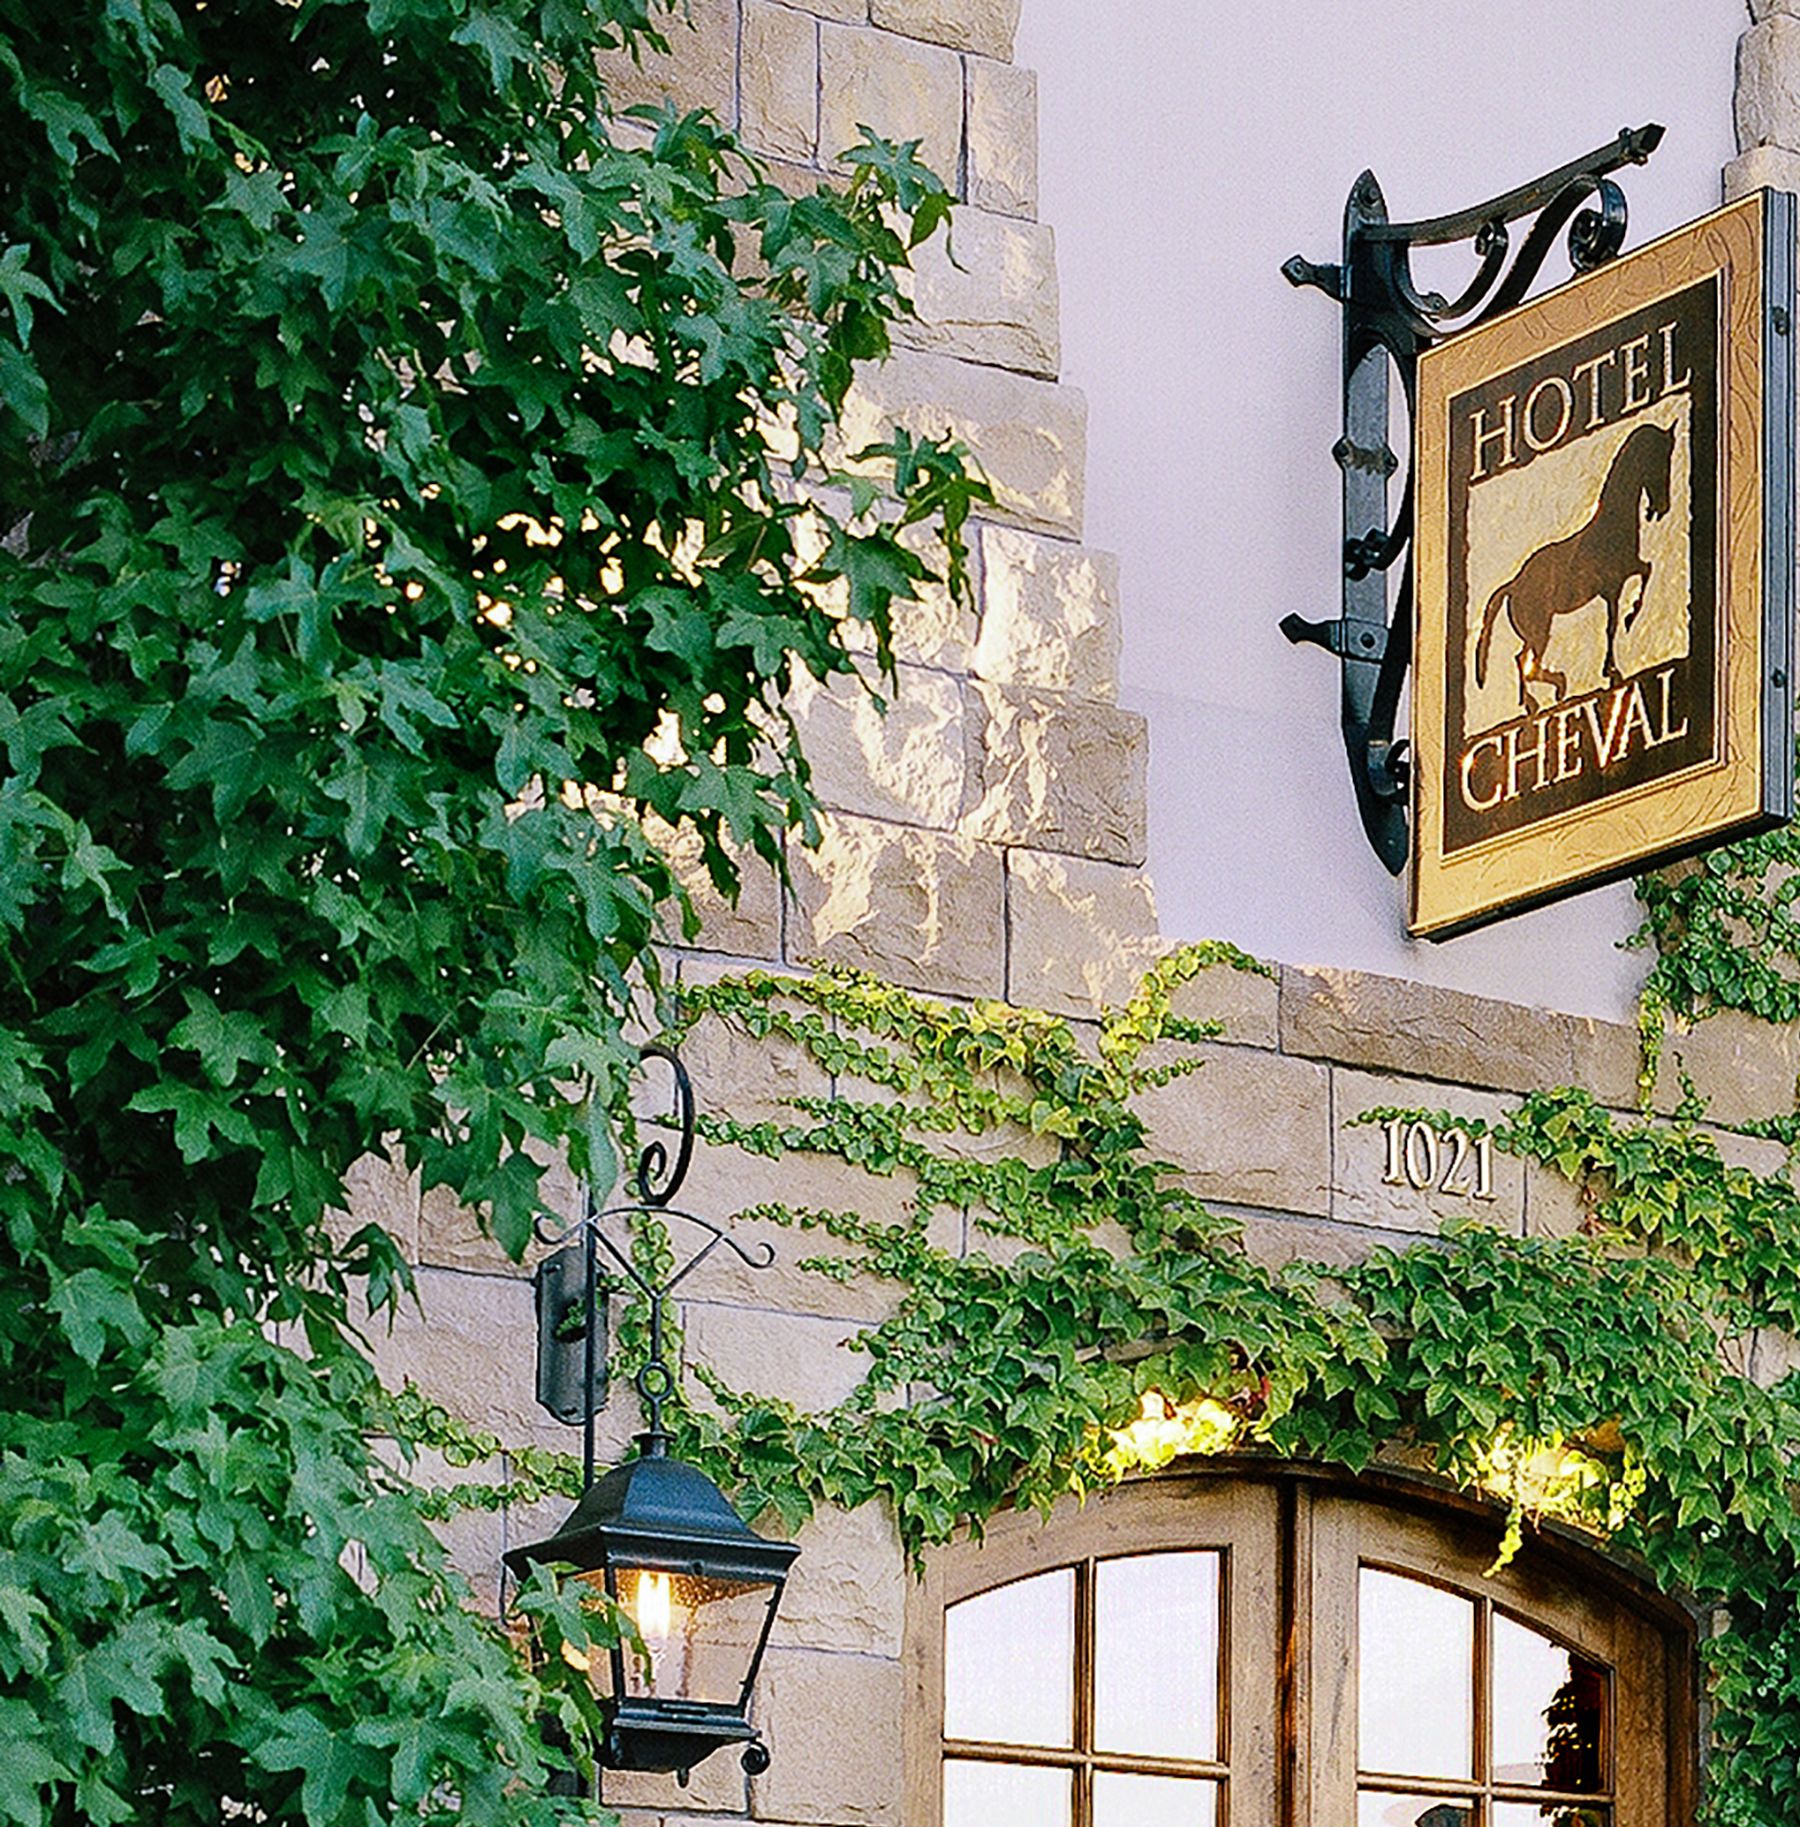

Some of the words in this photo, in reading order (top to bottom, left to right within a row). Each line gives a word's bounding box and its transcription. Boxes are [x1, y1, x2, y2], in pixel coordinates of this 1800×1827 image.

[1469, 321, 1693, 481] HOTEL
[1461, 667, 1690, 812] CHEVAL
[1381, 1117, 1499, 1201] 1021
